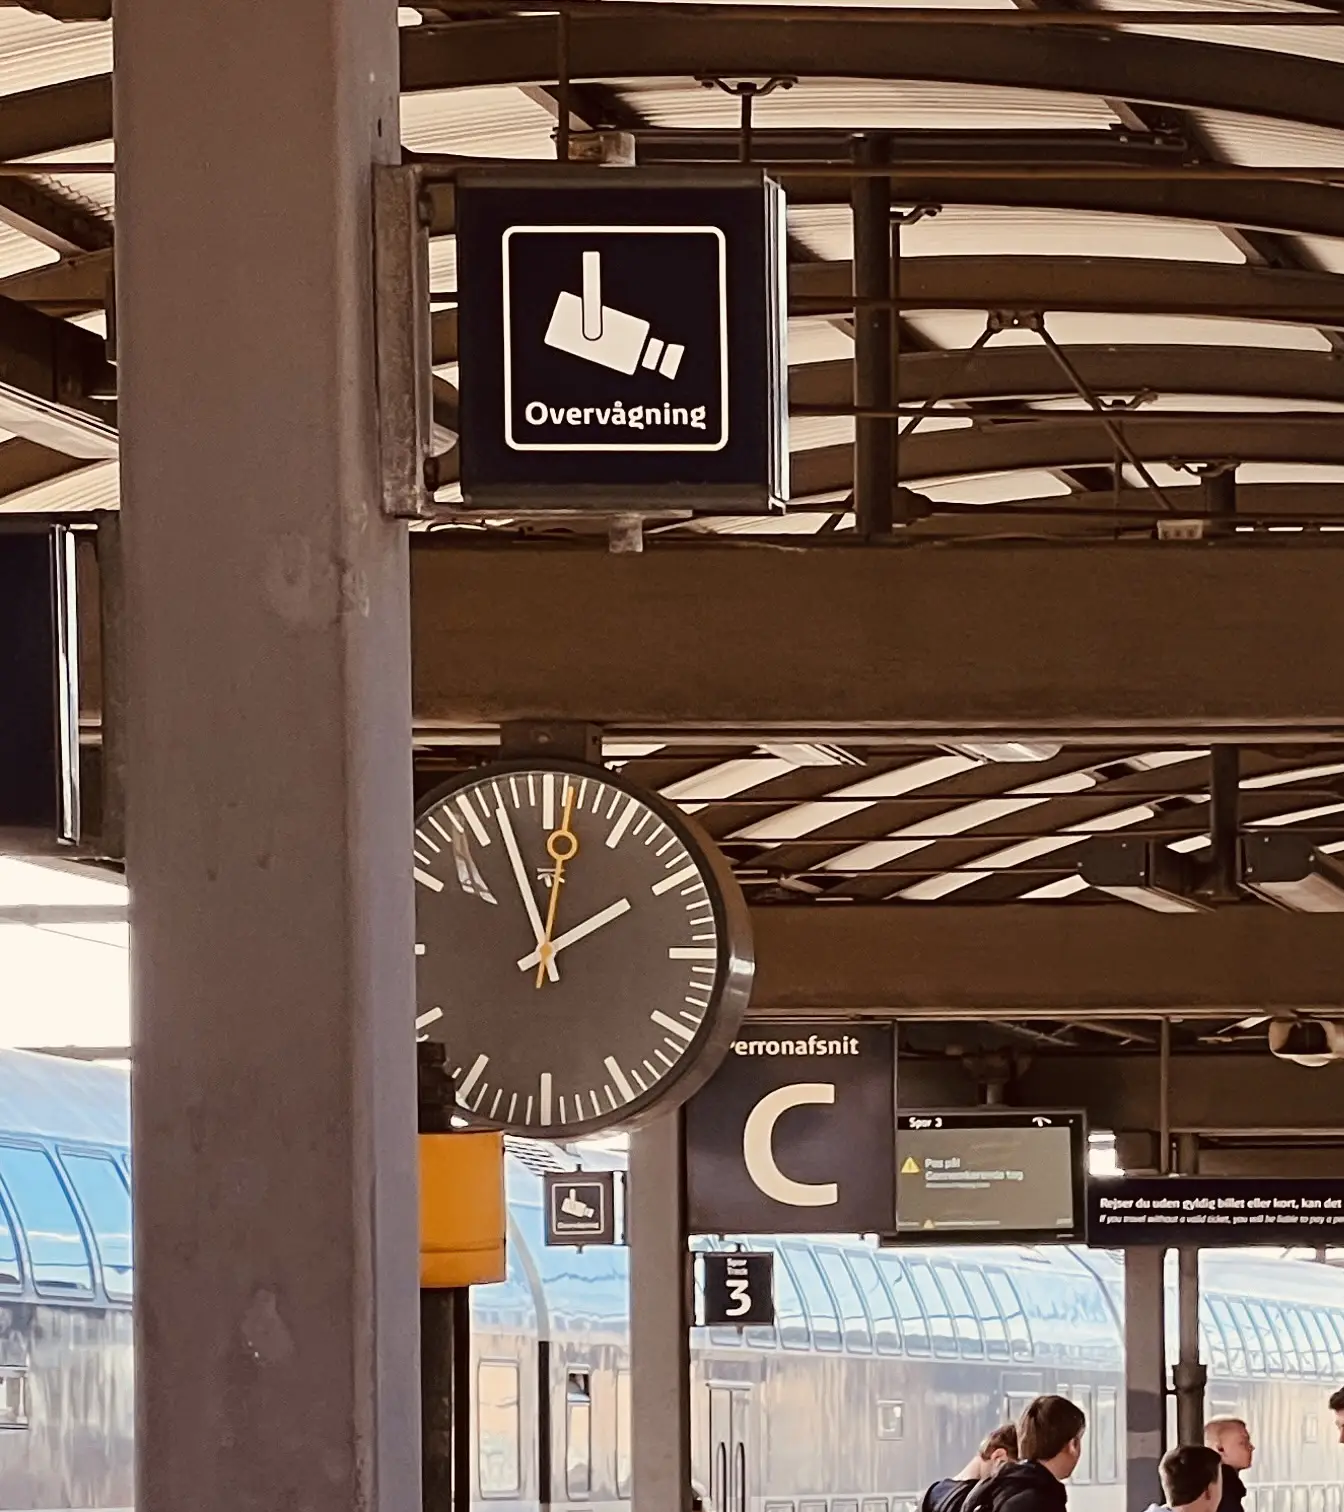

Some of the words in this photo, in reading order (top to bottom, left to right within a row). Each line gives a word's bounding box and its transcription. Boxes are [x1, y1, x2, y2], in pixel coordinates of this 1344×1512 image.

[524, 400, 707, 430] Overvågning
[729, 1035, 860, 1056] erronafsnit
[909, 1117, 933, 1129] Spor
[934, 1117, 943, 1128] 3
[743, 1083, 838, 1206] C
[1099, 1197, 1134, 1210] Rejser
[1135, 1197, 1150, 1209] du
[1152, 1197, 1180, 1209] uden
[1182, 1197, 1216, 1211] gyldig
[1217, 1197, 1245, 1209] billet
[1247, 1197, 1272, 1209] eller
[1273, 1197, 1299, 1210] kort,
[1301, 1197, 1321, 1209] kan
[1323, 1197, 1342, 1209] det
[725, 1279, 752, 1317] 3
